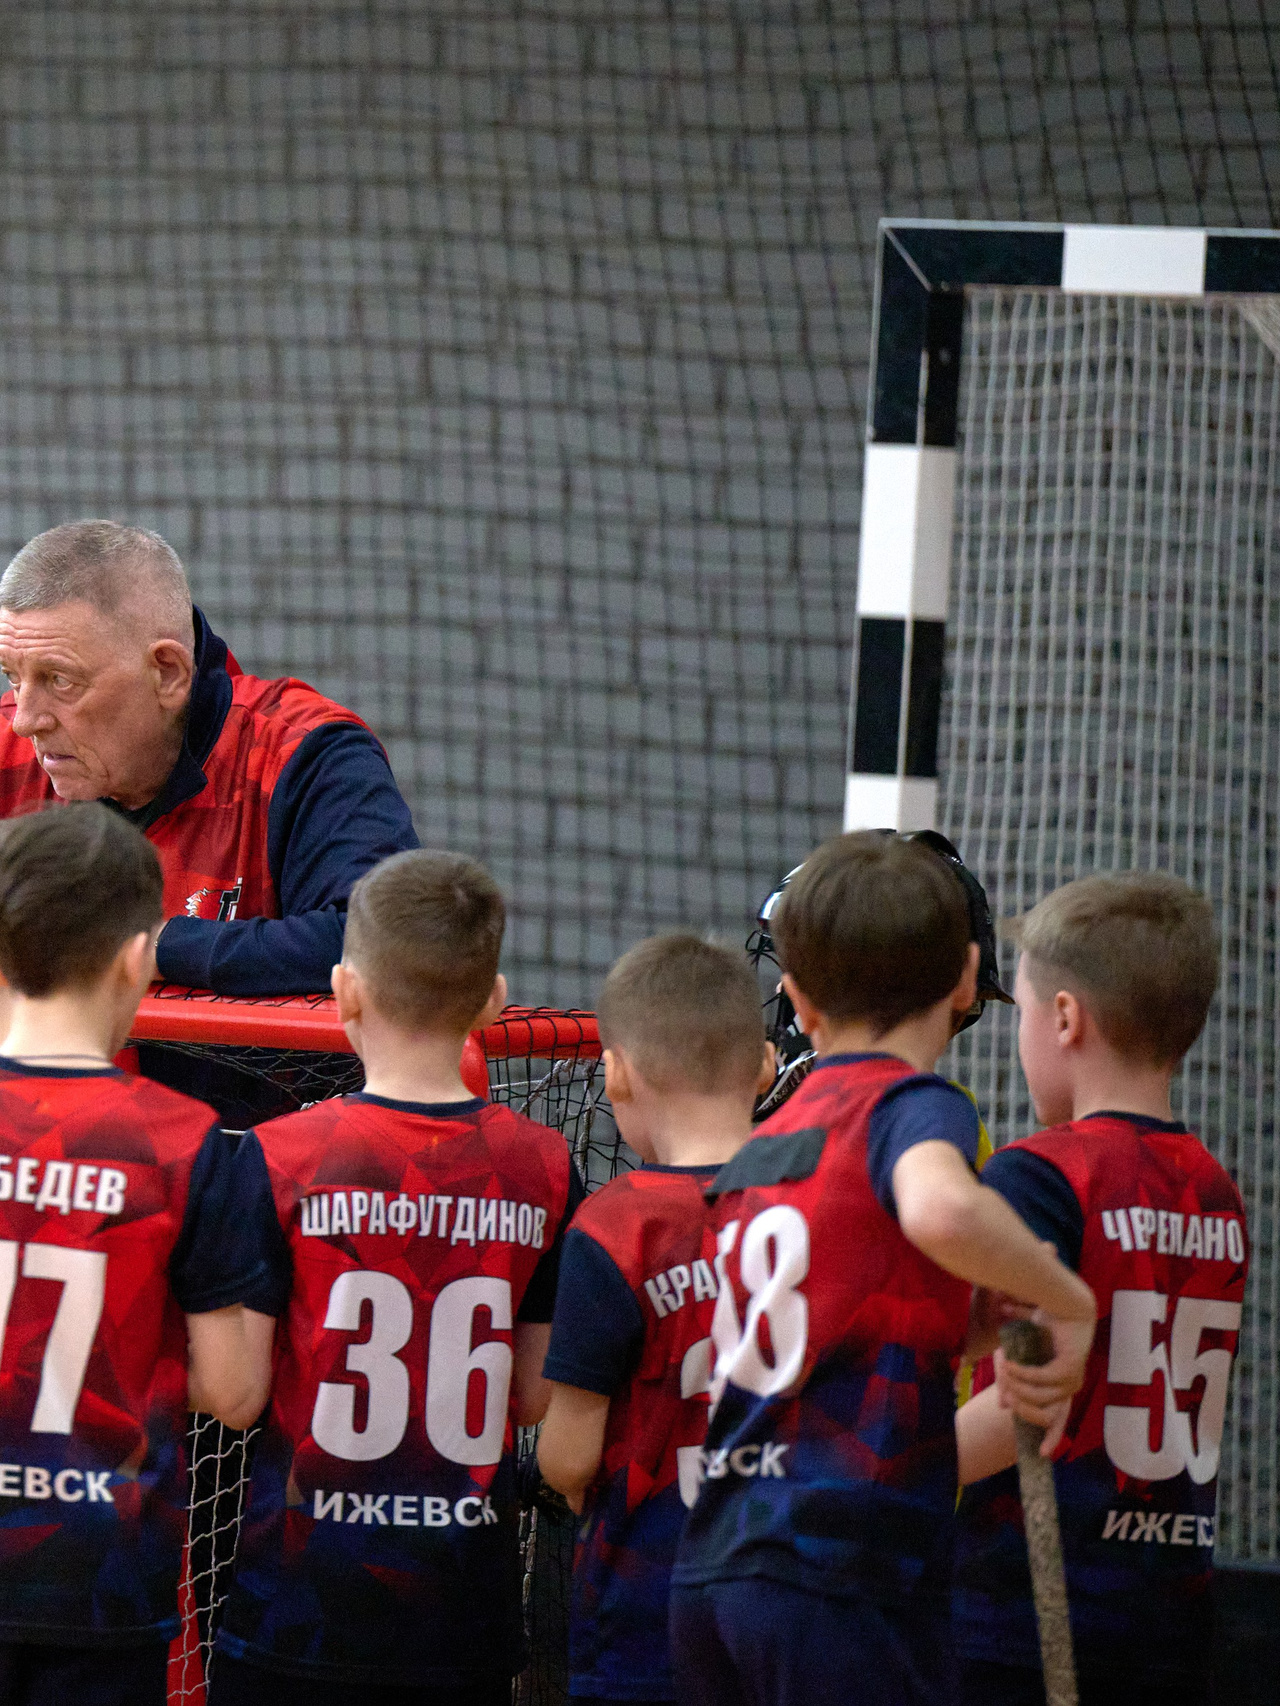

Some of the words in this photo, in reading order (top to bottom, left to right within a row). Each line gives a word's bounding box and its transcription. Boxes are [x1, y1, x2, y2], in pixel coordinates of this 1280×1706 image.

[299, 1191, 547, 1250] ШАРАФУТДИНОВ
[644, 1253, 725, 1318] КРА
[311, 1270, 514, 1467] 36
[1103, 1289, 1243, 1486] 55
